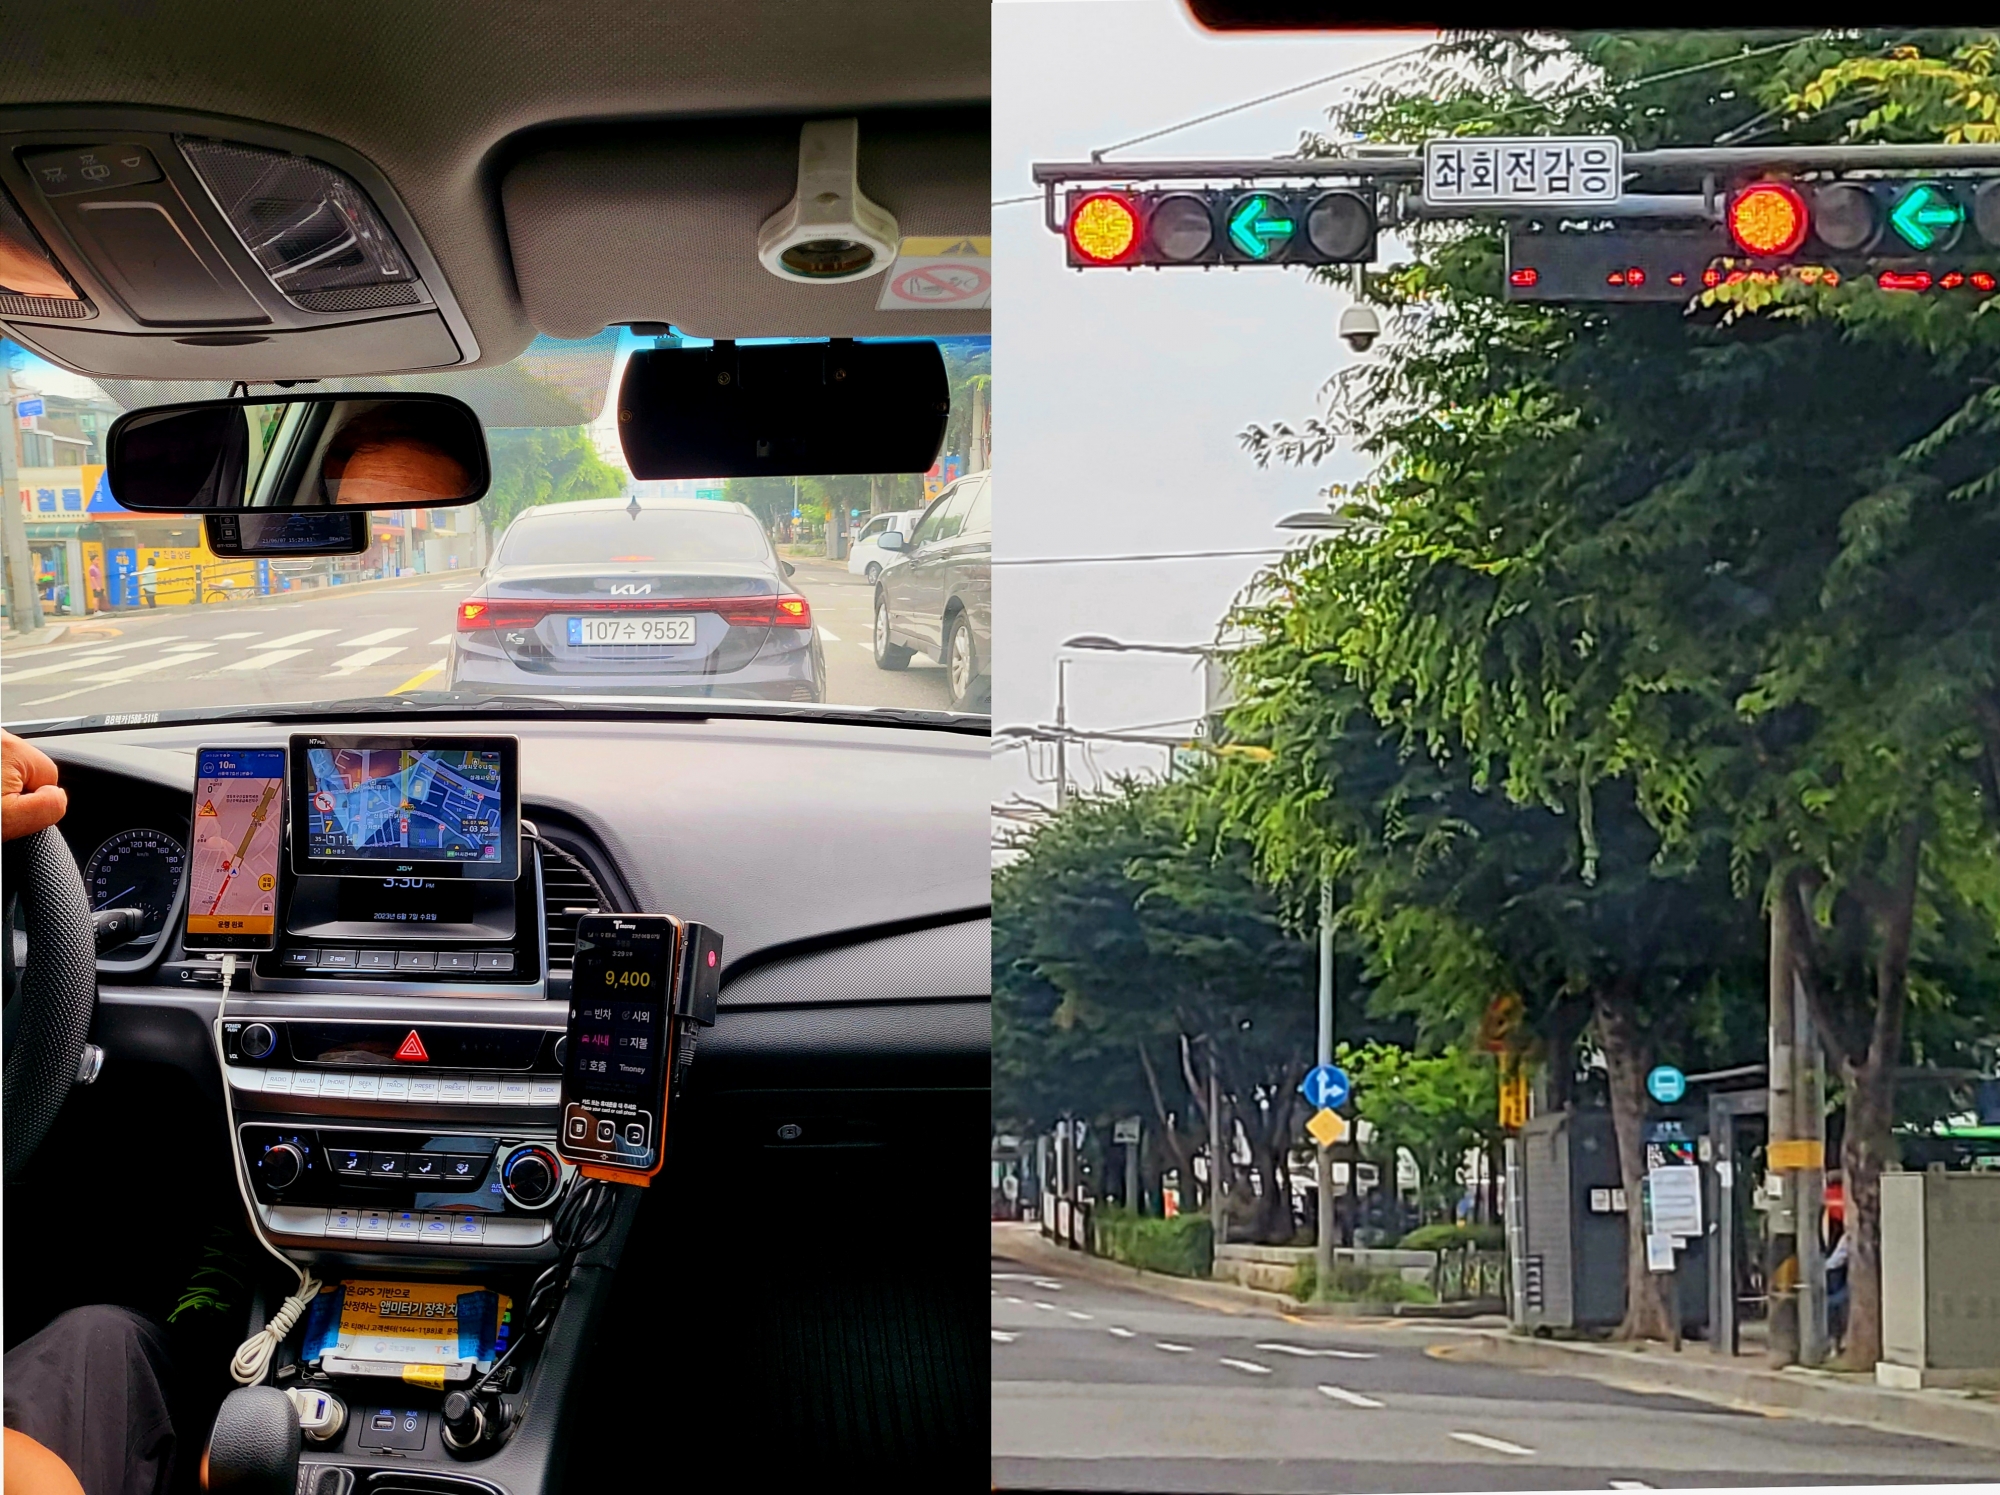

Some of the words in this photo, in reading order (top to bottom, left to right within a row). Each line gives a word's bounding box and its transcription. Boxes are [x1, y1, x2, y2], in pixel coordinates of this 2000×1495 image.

[1434, 148, 1612, 195] 좌회전감응
[611, 584, 652, 595] KIA
[505, 632, 526, 645] K3
[218, 761, 236, 769] 10m
[325, 821, 333, 832] 7
[374, 912, 395, 920] 2023년
[396, 912, 407, 920] 6월
[420, 913, 437, 921] 수요일
[613, 920, 636, 930] Tmoney
[605, 970, 651, 989] 9,400
[594, 1008, 612, 1020] 빈차
[631, 1010, 650, 1023] 시외
[592, 1034, 610, 1046] 시내
[630, 1037, 648, 1050] 지불
[589, 1060, 607, 1073] 호출
[619, 1063, 646, 1075] Tmoney
[357, 1287, 375, 1296] GPS
[377, 1287, 410, 1298] 기반으로
[343, 1300, 377, 1313] 산정하는
[380, 1300, 423, 1316] 앱미터기
[424, 1302, 447, 1316] 장착
[351, 1322, 370, 1331] 티머니
[435, 1346, 450, 1354] TS
